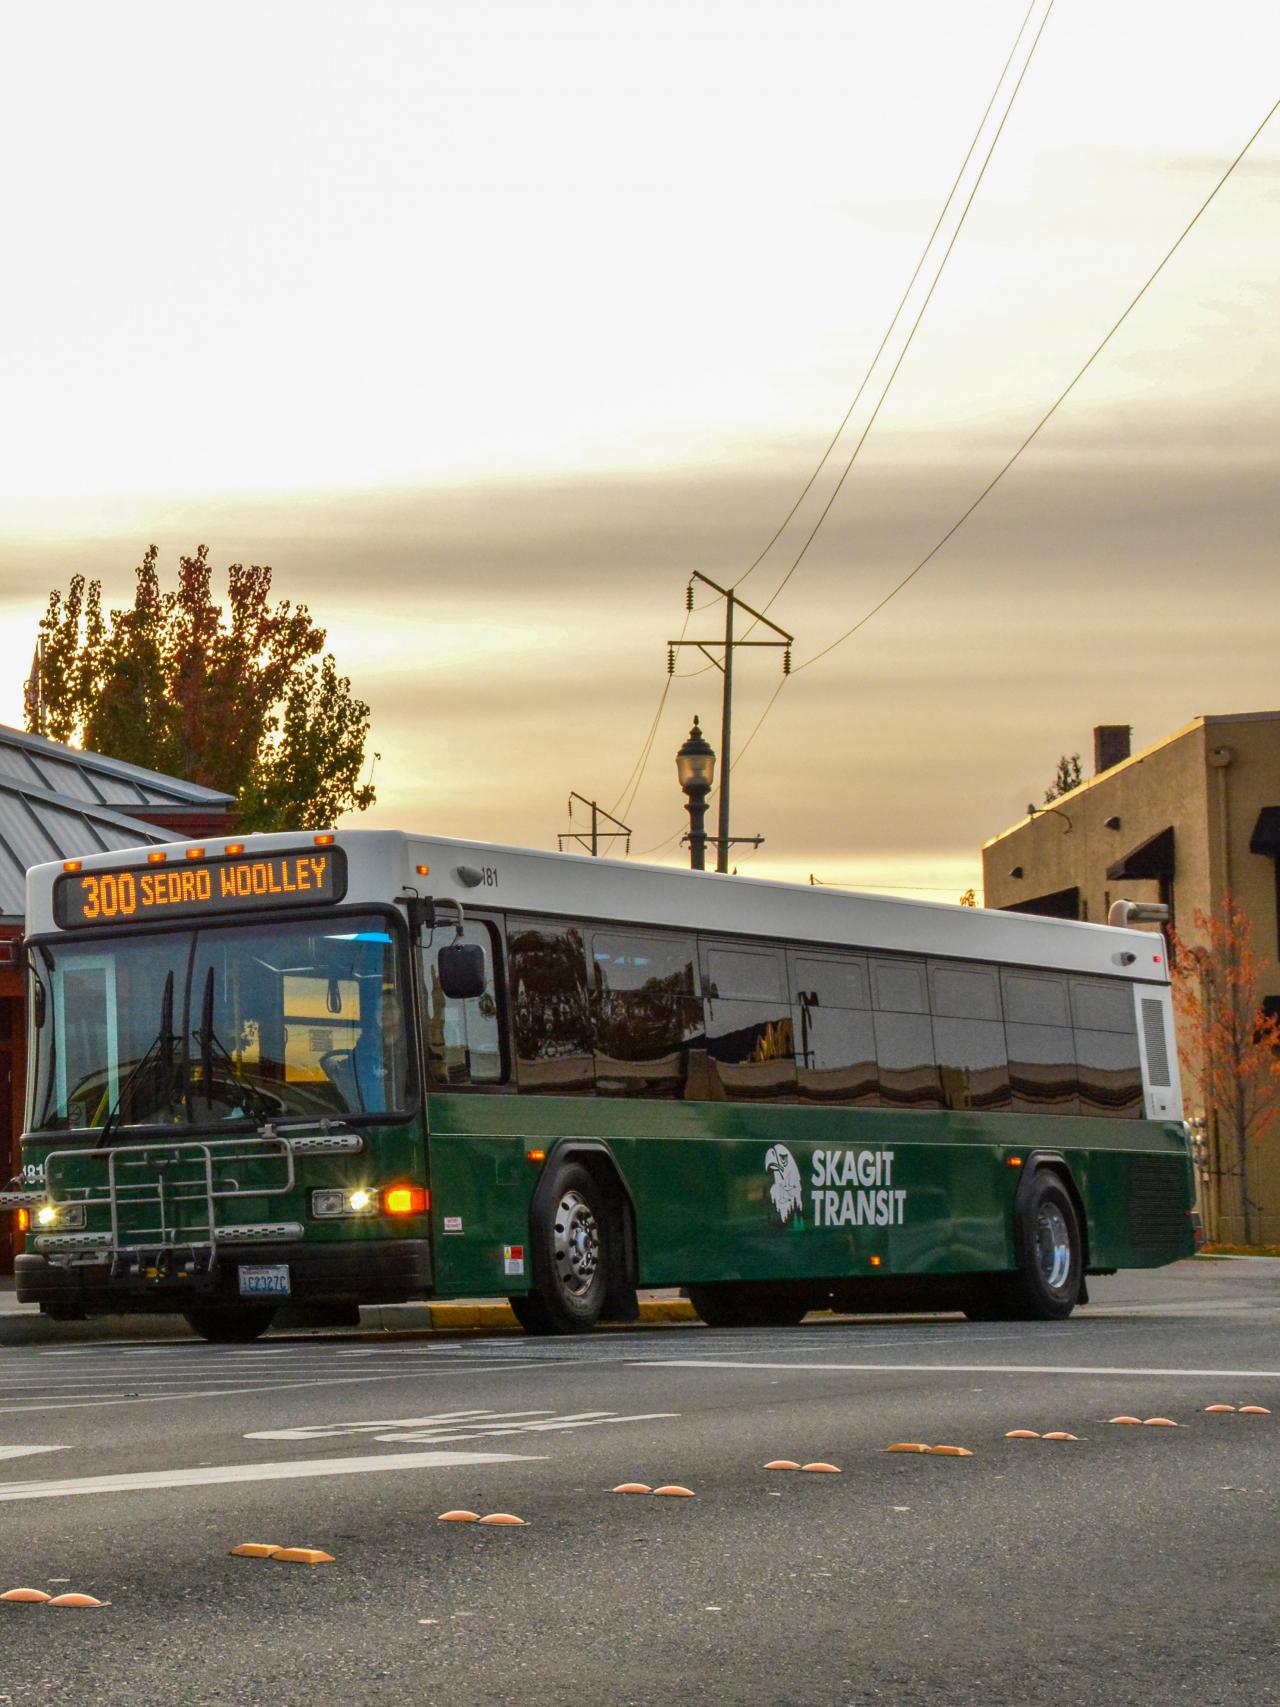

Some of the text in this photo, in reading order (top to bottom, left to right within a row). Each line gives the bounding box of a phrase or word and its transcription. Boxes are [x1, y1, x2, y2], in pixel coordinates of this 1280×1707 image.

[81, 856, 326, 920] 300 SEDRO WOOLLEY
[482, 867, 498, 887] 181
[23, 1164, 44, 1184] 181
[811, 1149, 894, 1187] SKAGIT
[811, 1190, 907, 1226] TRANSIT
